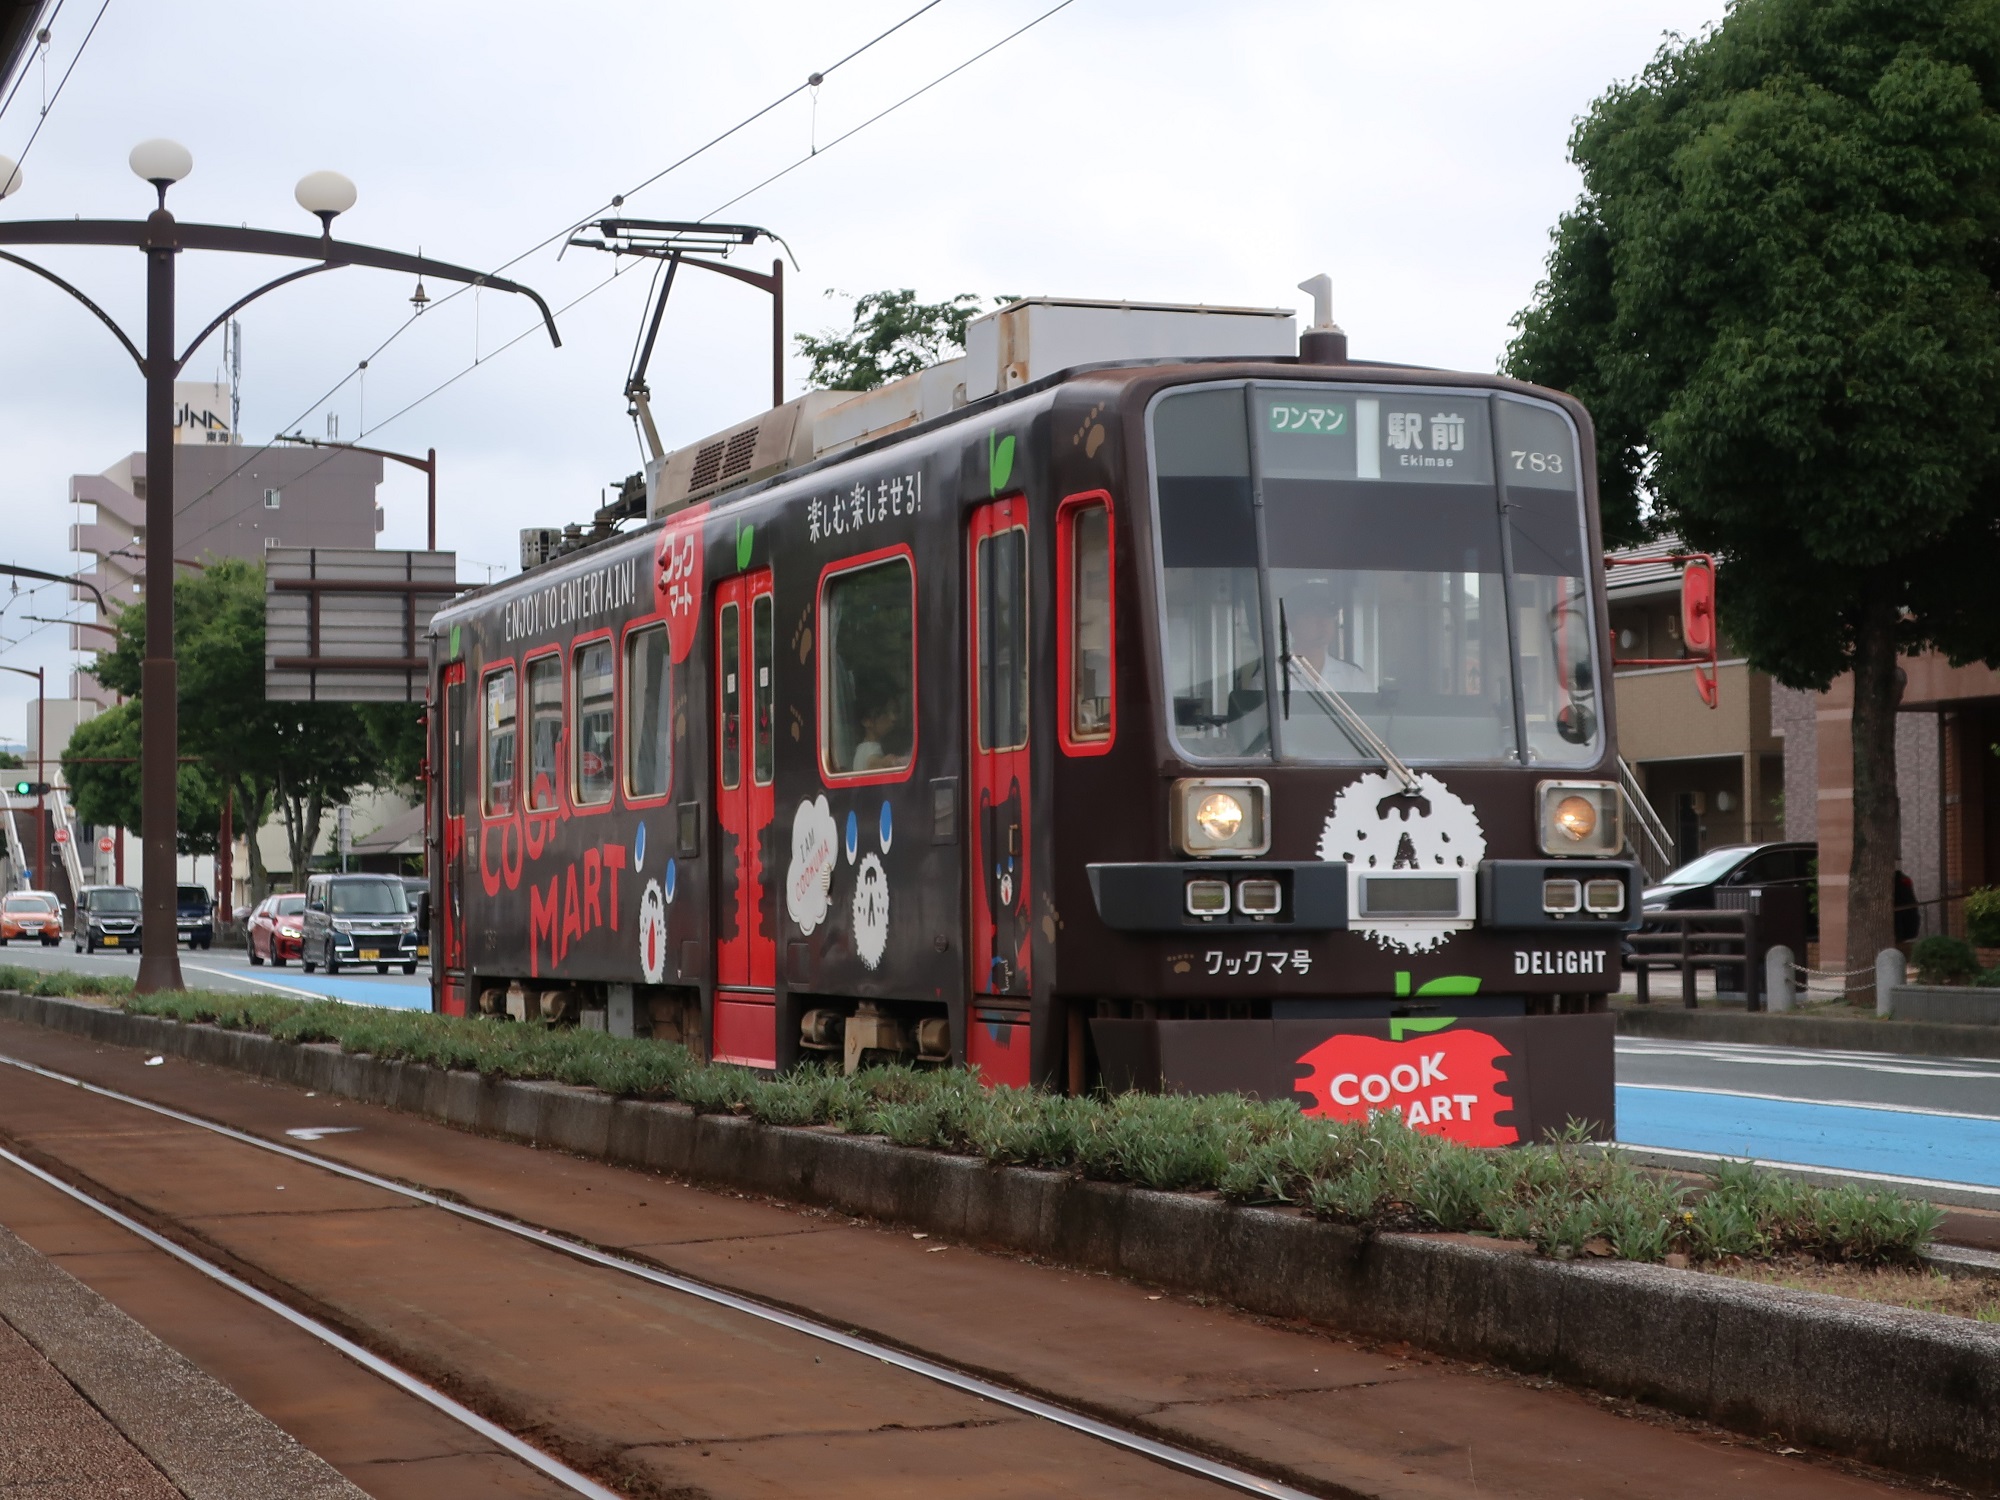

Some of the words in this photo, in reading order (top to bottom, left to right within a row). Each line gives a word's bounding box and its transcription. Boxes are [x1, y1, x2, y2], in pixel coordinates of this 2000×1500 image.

[1272, 406, 1344, 431] ワンマン
[1387, 412, 1465, 452] 駅前
[1400, 454, 1454, 468] Ekimae
[1511, 449, 1563, 474] 783
[660, 532, 694, 584] クック
[505, 591, 544, 642] ENJOY,
[544, 584, 558, 631] TO
[560, 557, 636, 626] ENTERTAIN!
[669, 581, 693, 618] マート
[805, 827, 816, 853] AM
[530, 843, 626, 978] MART
[1205, 949, 1313, 976] クックマ号
[1330, 1052, 1449, 1106] COOK
